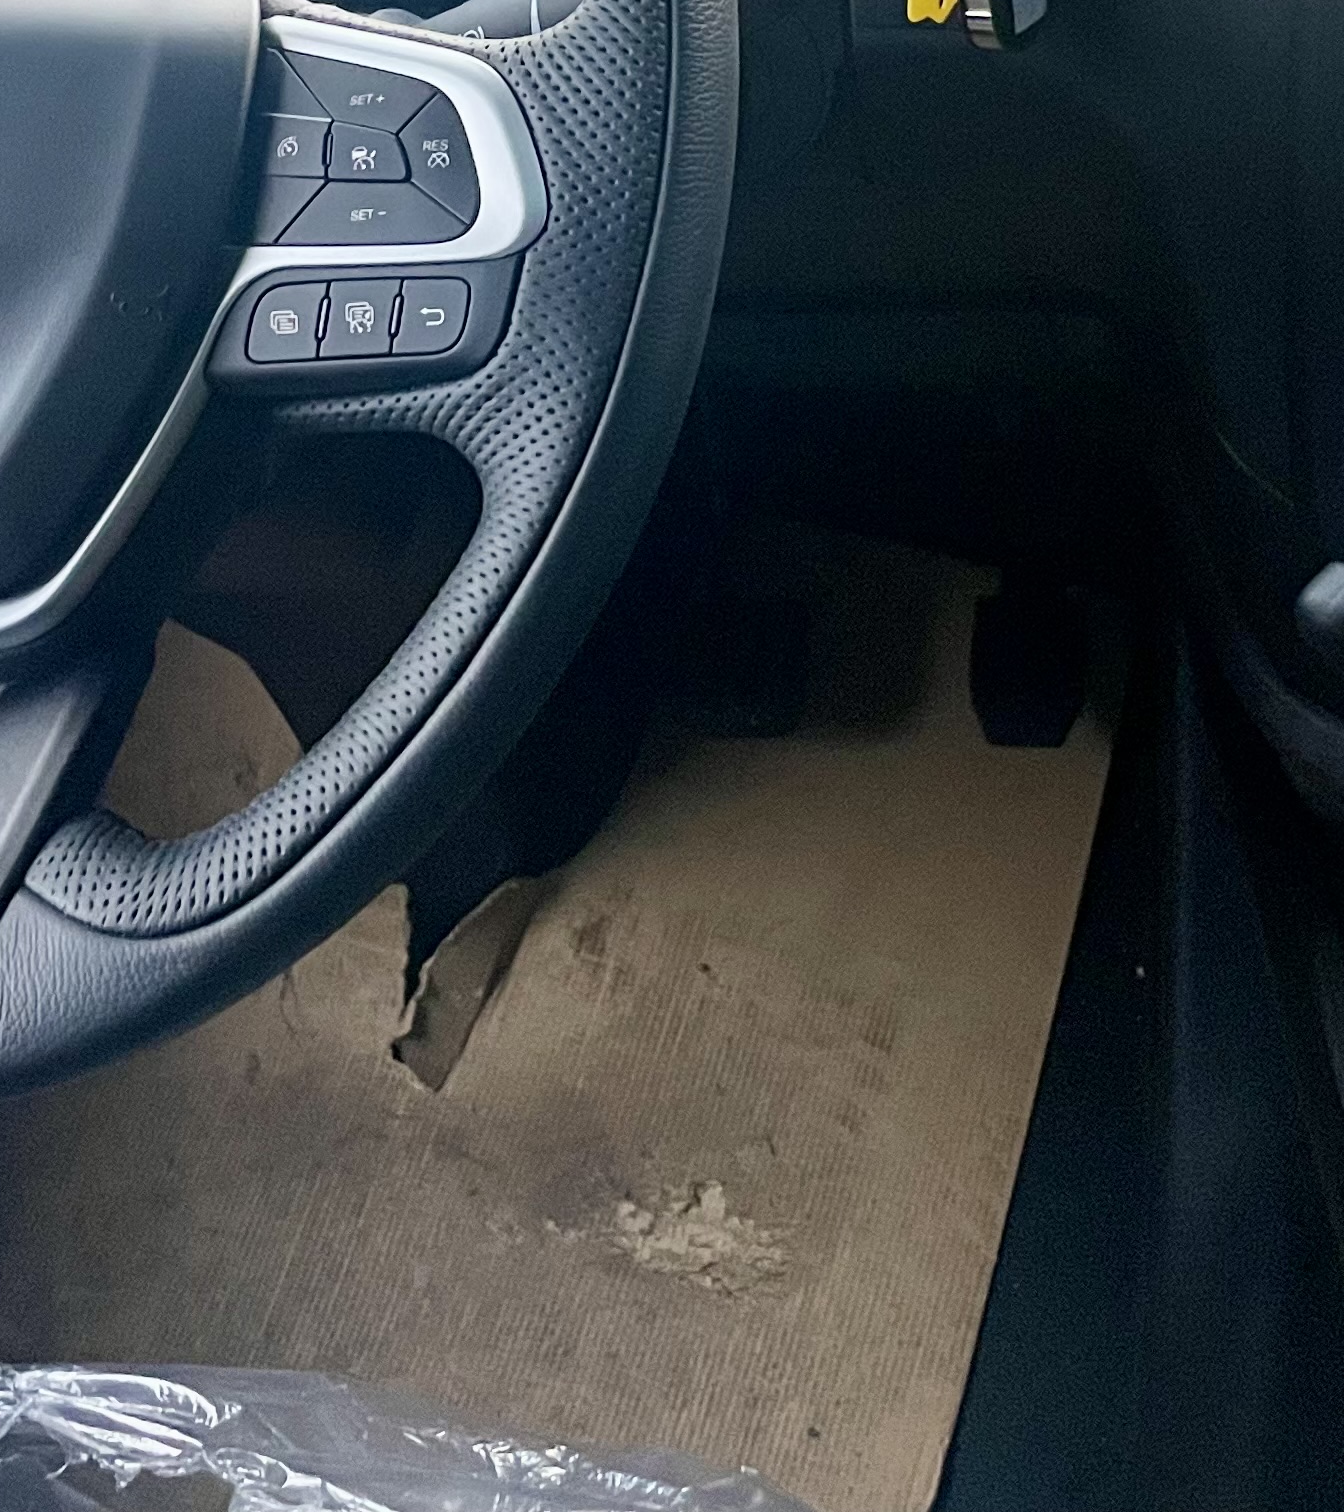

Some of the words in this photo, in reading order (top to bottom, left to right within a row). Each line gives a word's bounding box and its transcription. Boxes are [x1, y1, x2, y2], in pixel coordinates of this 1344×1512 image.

[349, 93, 374, 106] SET
[422, 139, 449, 151] RES
[350, 208, 374, 221] SET
